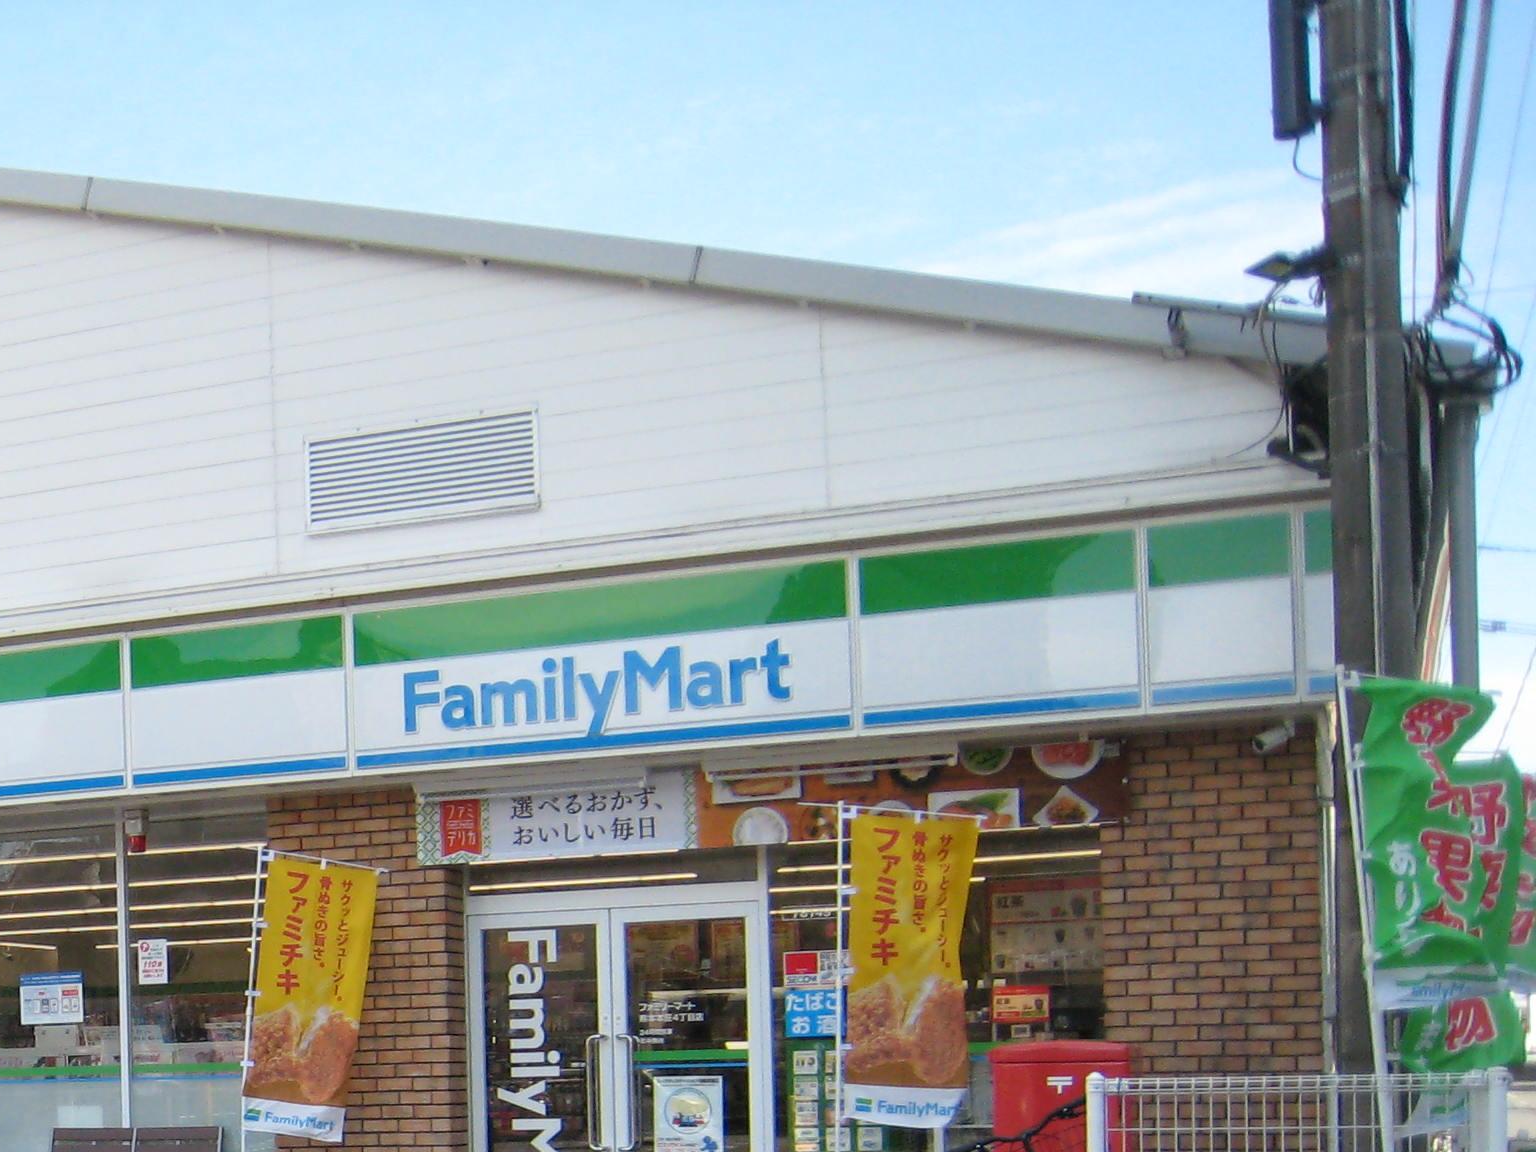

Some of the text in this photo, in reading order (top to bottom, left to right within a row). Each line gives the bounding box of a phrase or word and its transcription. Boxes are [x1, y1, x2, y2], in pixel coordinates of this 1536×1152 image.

[402, 637, 793, 736] FamilyMart
[445, 803, 474, 820] ファミ
[511, 786, 664, 820] 選べるおかず、
[447, 830, 476, 848] デリカ
[512, 816, 657, 846] おいしい毎日
[870, 827, 901, 966] ファミチキ
[276, 870, 312, 996] ファミチキ
[786, 992, 837, 1011] たばこ
[877, 1099, 957, 1117] FamilyMar
[264, 1111, 336, 1133] FamilyMart
